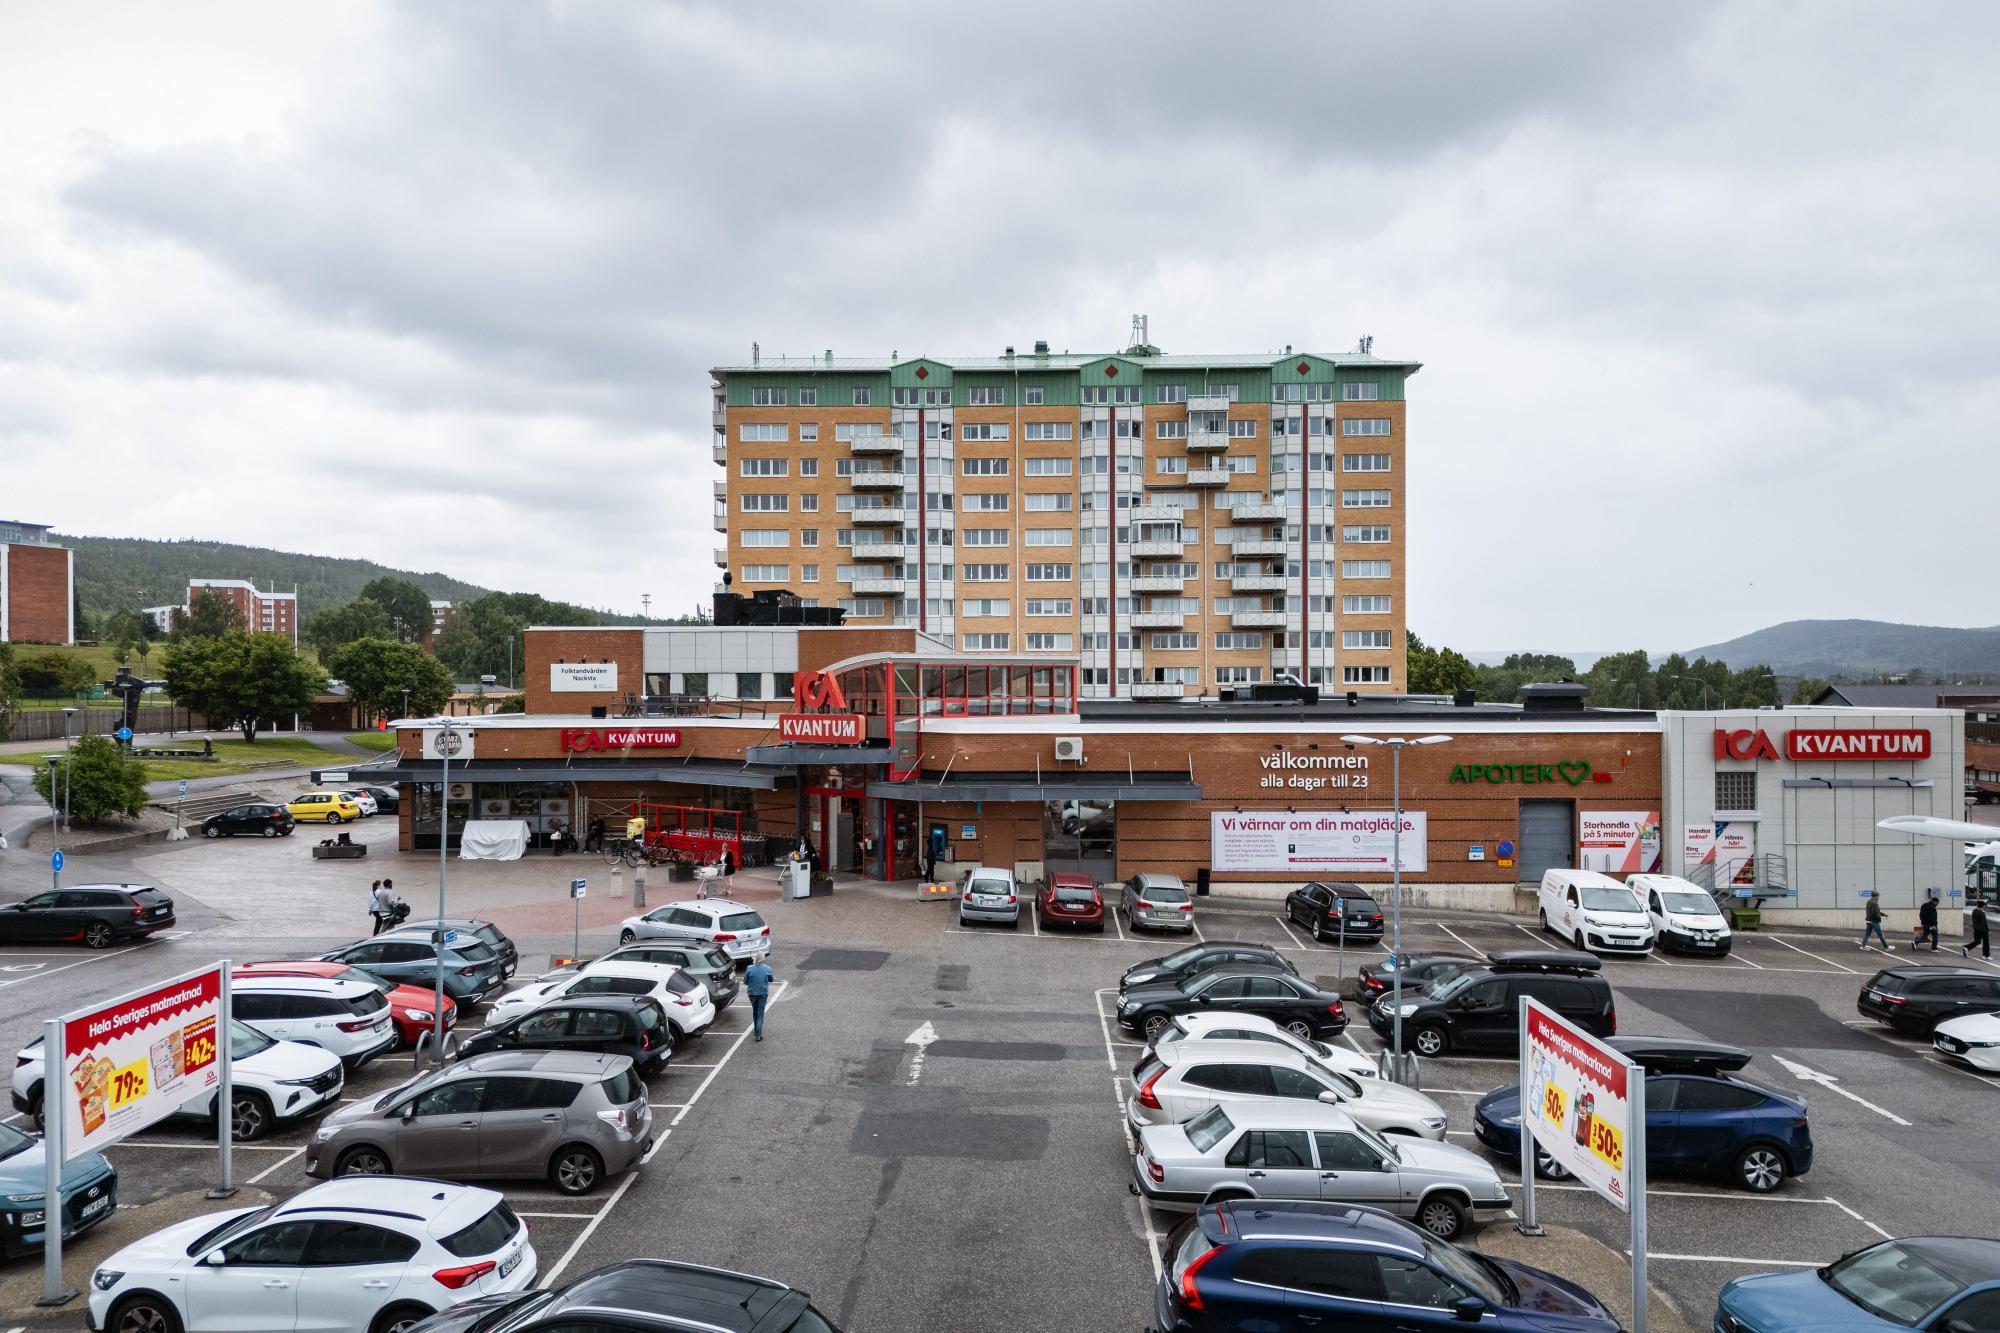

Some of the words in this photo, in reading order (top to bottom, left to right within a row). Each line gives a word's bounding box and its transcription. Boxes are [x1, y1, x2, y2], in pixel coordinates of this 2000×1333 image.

[793, 669, 848, 712] ICA
[783, 719, 856, 737] KVANTUM
[561, 728, 606, 752] ICA
[608, 733, 676, 744] KVANTUM
[1714, 729, 1781, 761] ICA
[1796, 735, 1923, 753] KVANTUM
[1260, 751, 1369, 769] välkommen
[1260, 773, 1284, 788] alla
[1288, 773, 1327, 791] dagar
[1331, 773, 1348, 788] till
[1352, 775, 1368, 788] 23
[1450, 763, 1555, 784] APOTEK
[1221, 818, 1236, 831] Vi
[1239, 818, 1286, 831] värnar
[1289, 821, 1312, 831] om
[1315, 818, 1337, 831] din
[1583, 821, 1630, 829] Storhandla
[1583, 830, 1595, 839] på
[1603, 830, 1635, 838] minuter
[89, 1018, 112, 1038] Hela
[113, 1005, 150, 1029] Sveriges
[150, 983, 203, 1014] matmarknad
[1538, 1020, 1550, 1040] Hela
[1550, 1028, 1573, 1054] Sveriges
[1572, 1045, 1612, 1080] matmarknad
[114, 1071, 144, 1104] 79:-
[1597, 1122, 1623, 1162] 50:-
